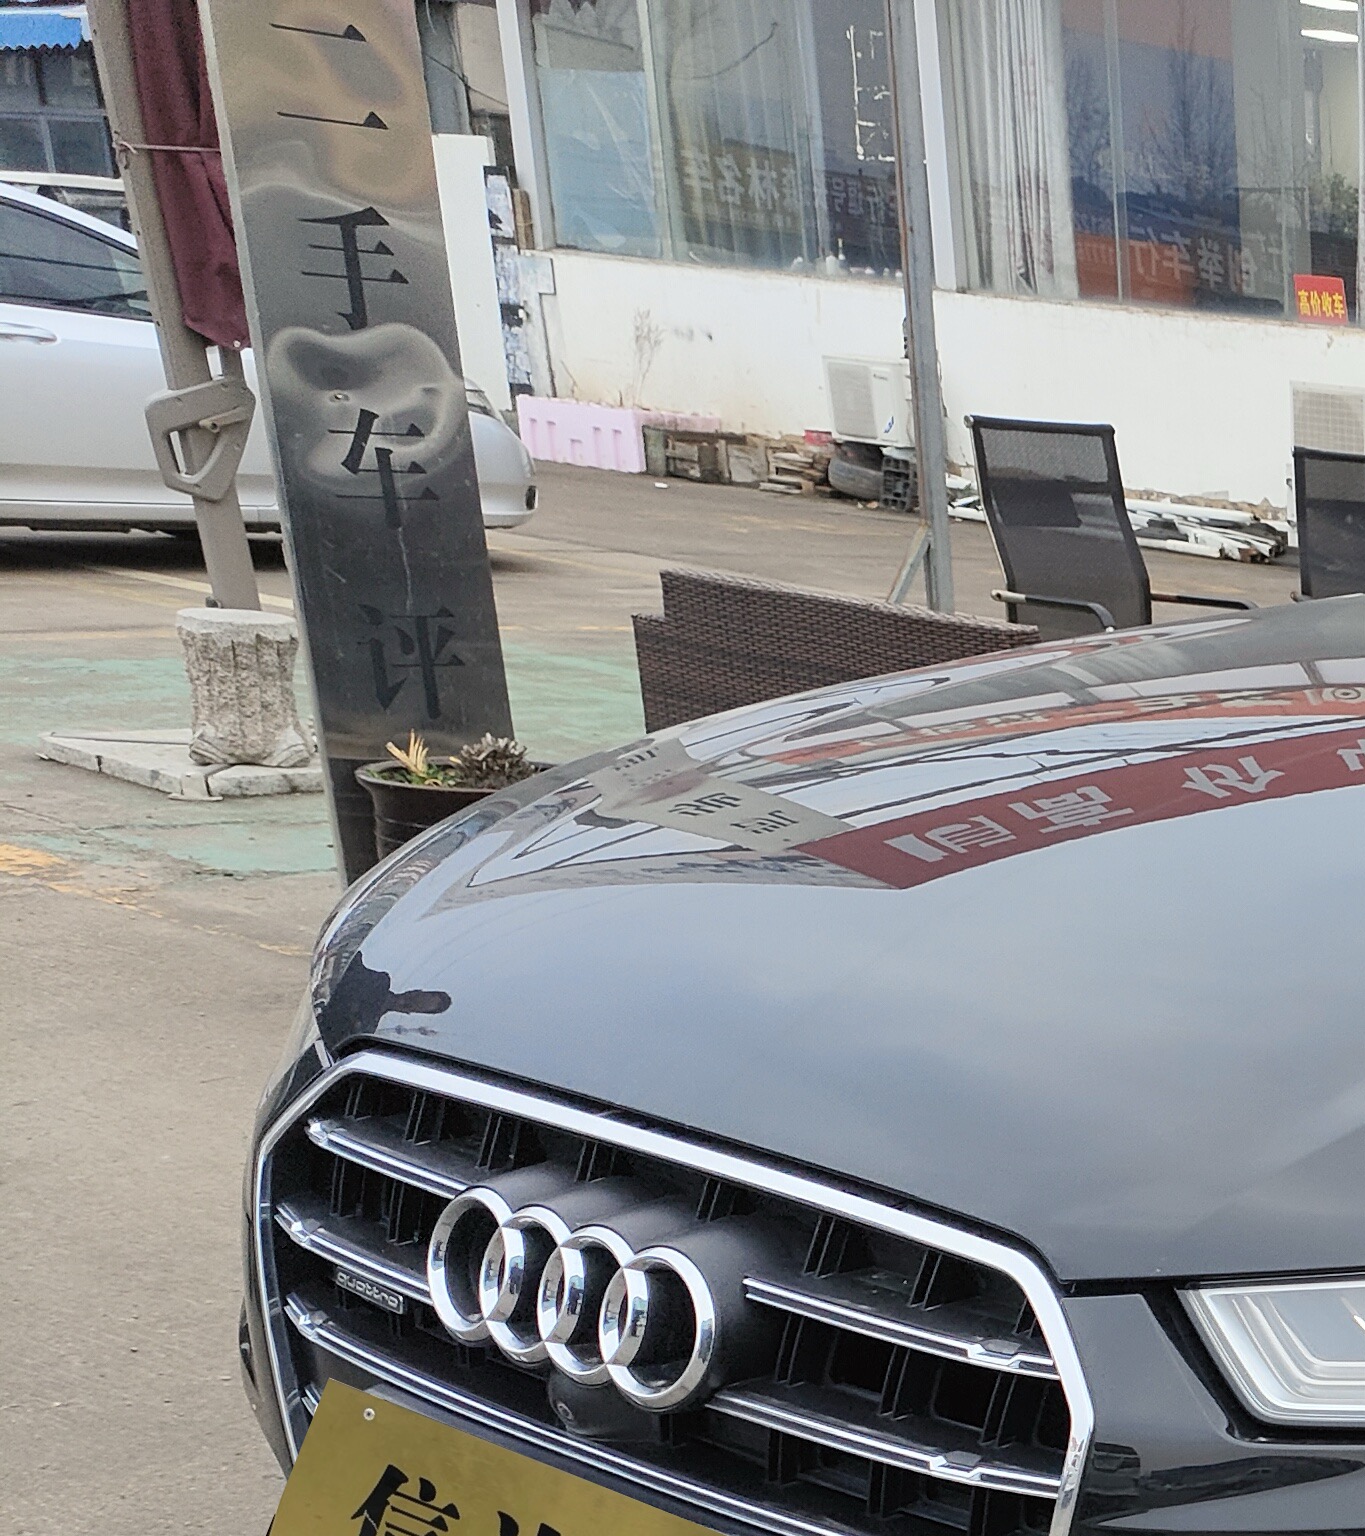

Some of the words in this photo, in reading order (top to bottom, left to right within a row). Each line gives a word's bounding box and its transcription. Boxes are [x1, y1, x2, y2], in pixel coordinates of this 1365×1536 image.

[1297, 289, 1345, 318] 高价收车
[269, 23, 466, 720] 二手车评
[337, 1272, 399, 1308] quattro
